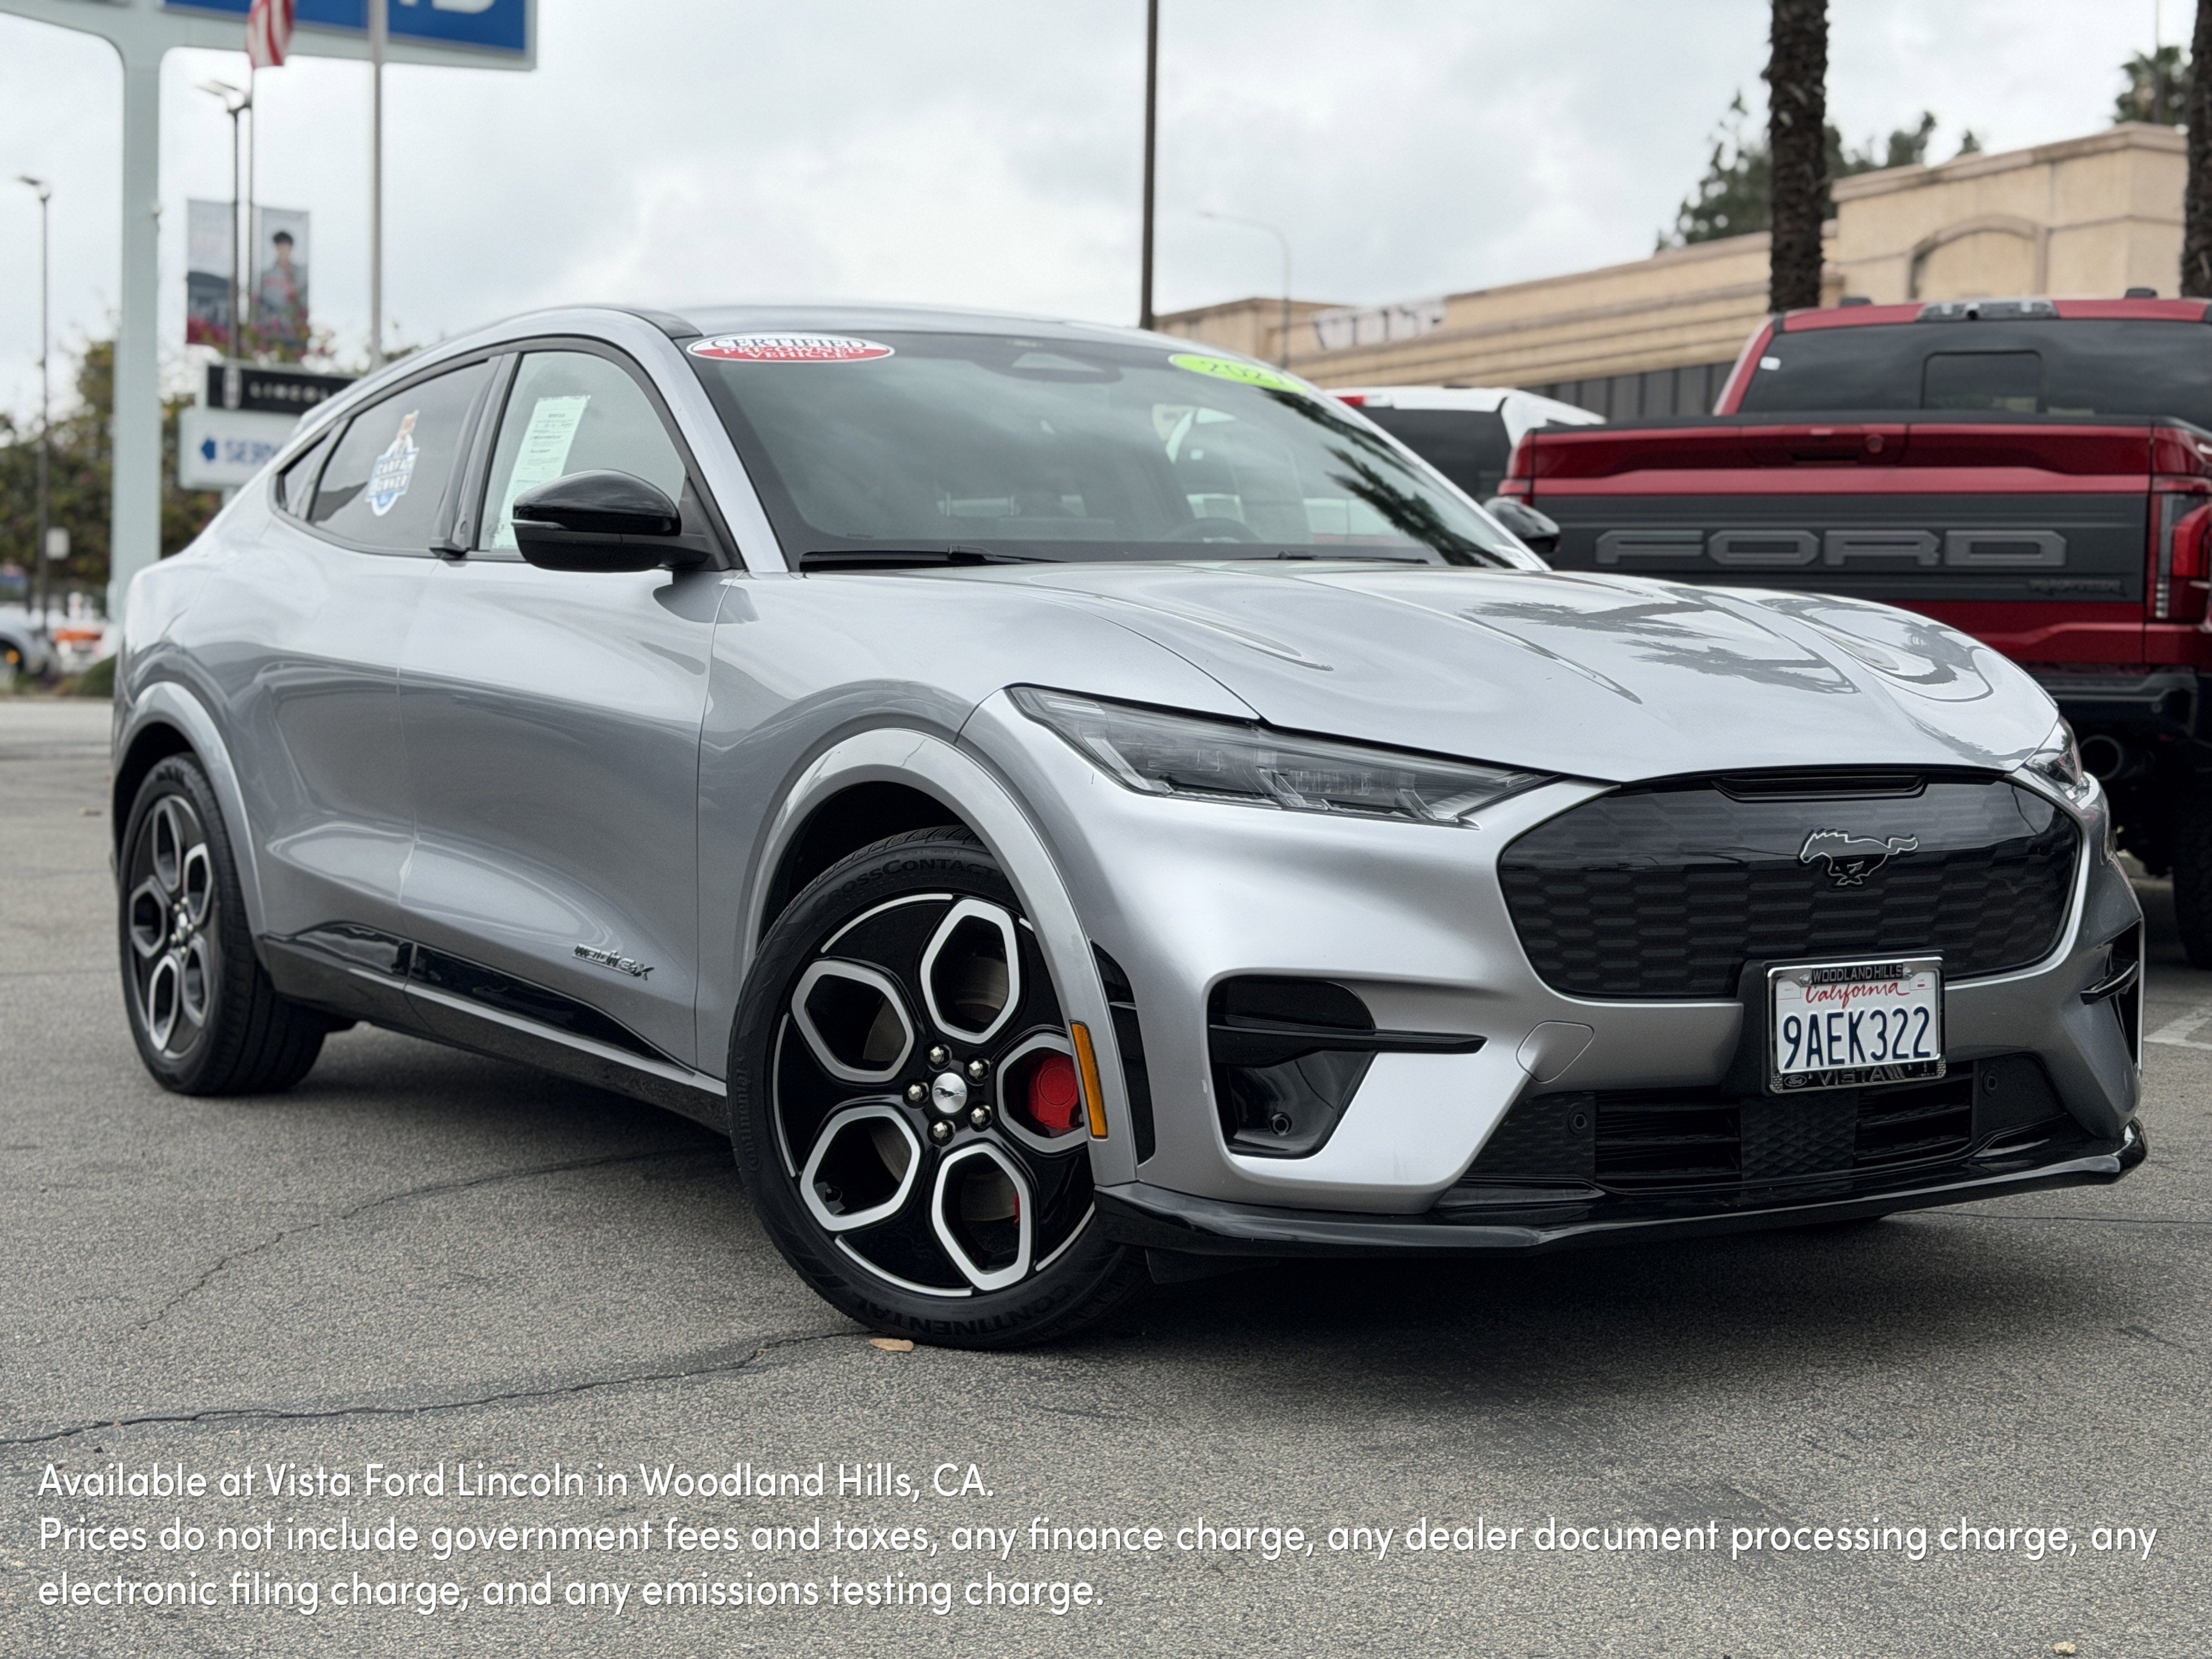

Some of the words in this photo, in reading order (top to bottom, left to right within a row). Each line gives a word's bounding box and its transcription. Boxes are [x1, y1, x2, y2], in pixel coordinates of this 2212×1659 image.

[710, 338, 867, 349] CERTIFIED
[722, 346, 865, 355] PRE-OWNED
[744, 350, 849, 359] VEHICLE
[1594, 529, 2068, 567] FORD
[1813, 967, 1872, 983] WOODLAND
[1874, 964, 1903, 979] HILLS
[1805, 981, 1910, 1009] California
[1783, 1006, 1931, 1070] 9AEK322
[1818, 1065, 1886, 1086] VISTA
